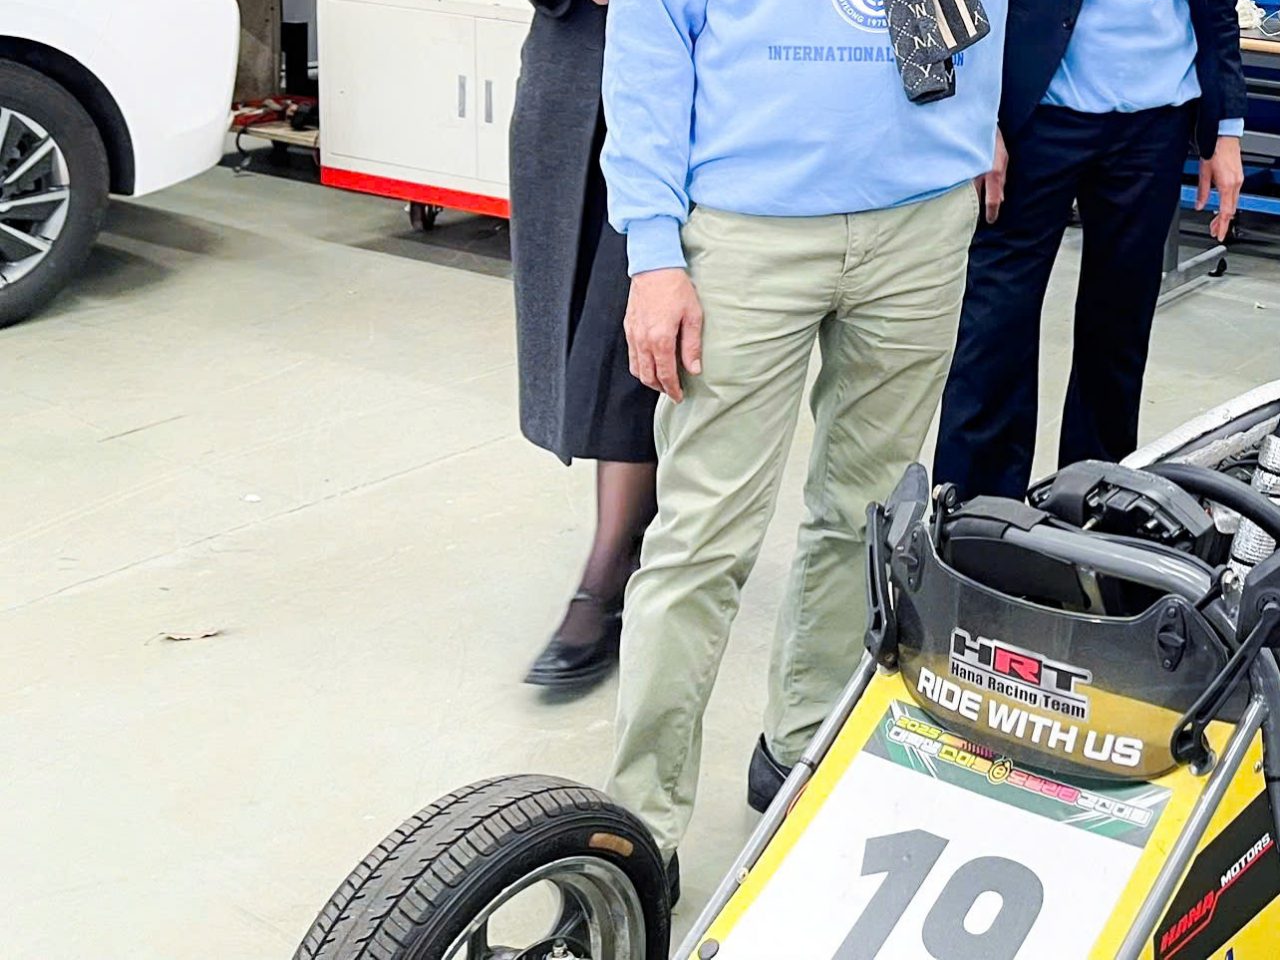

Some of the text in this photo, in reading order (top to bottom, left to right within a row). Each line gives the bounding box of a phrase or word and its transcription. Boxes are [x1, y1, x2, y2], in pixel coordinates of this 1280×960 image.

[768, 45, 894, 63] INTERNATIONAL
[951, 661, 1086, 719] Hana Racing Team
[953, 633, 1088, 693] HRT
[917, 666, 982, 722] RIDE
[988, 699, 1078, 754] WITH
[1083, 729, 1144, 768] US
[1160, 832, 1271, 952] HANA MOTORS
